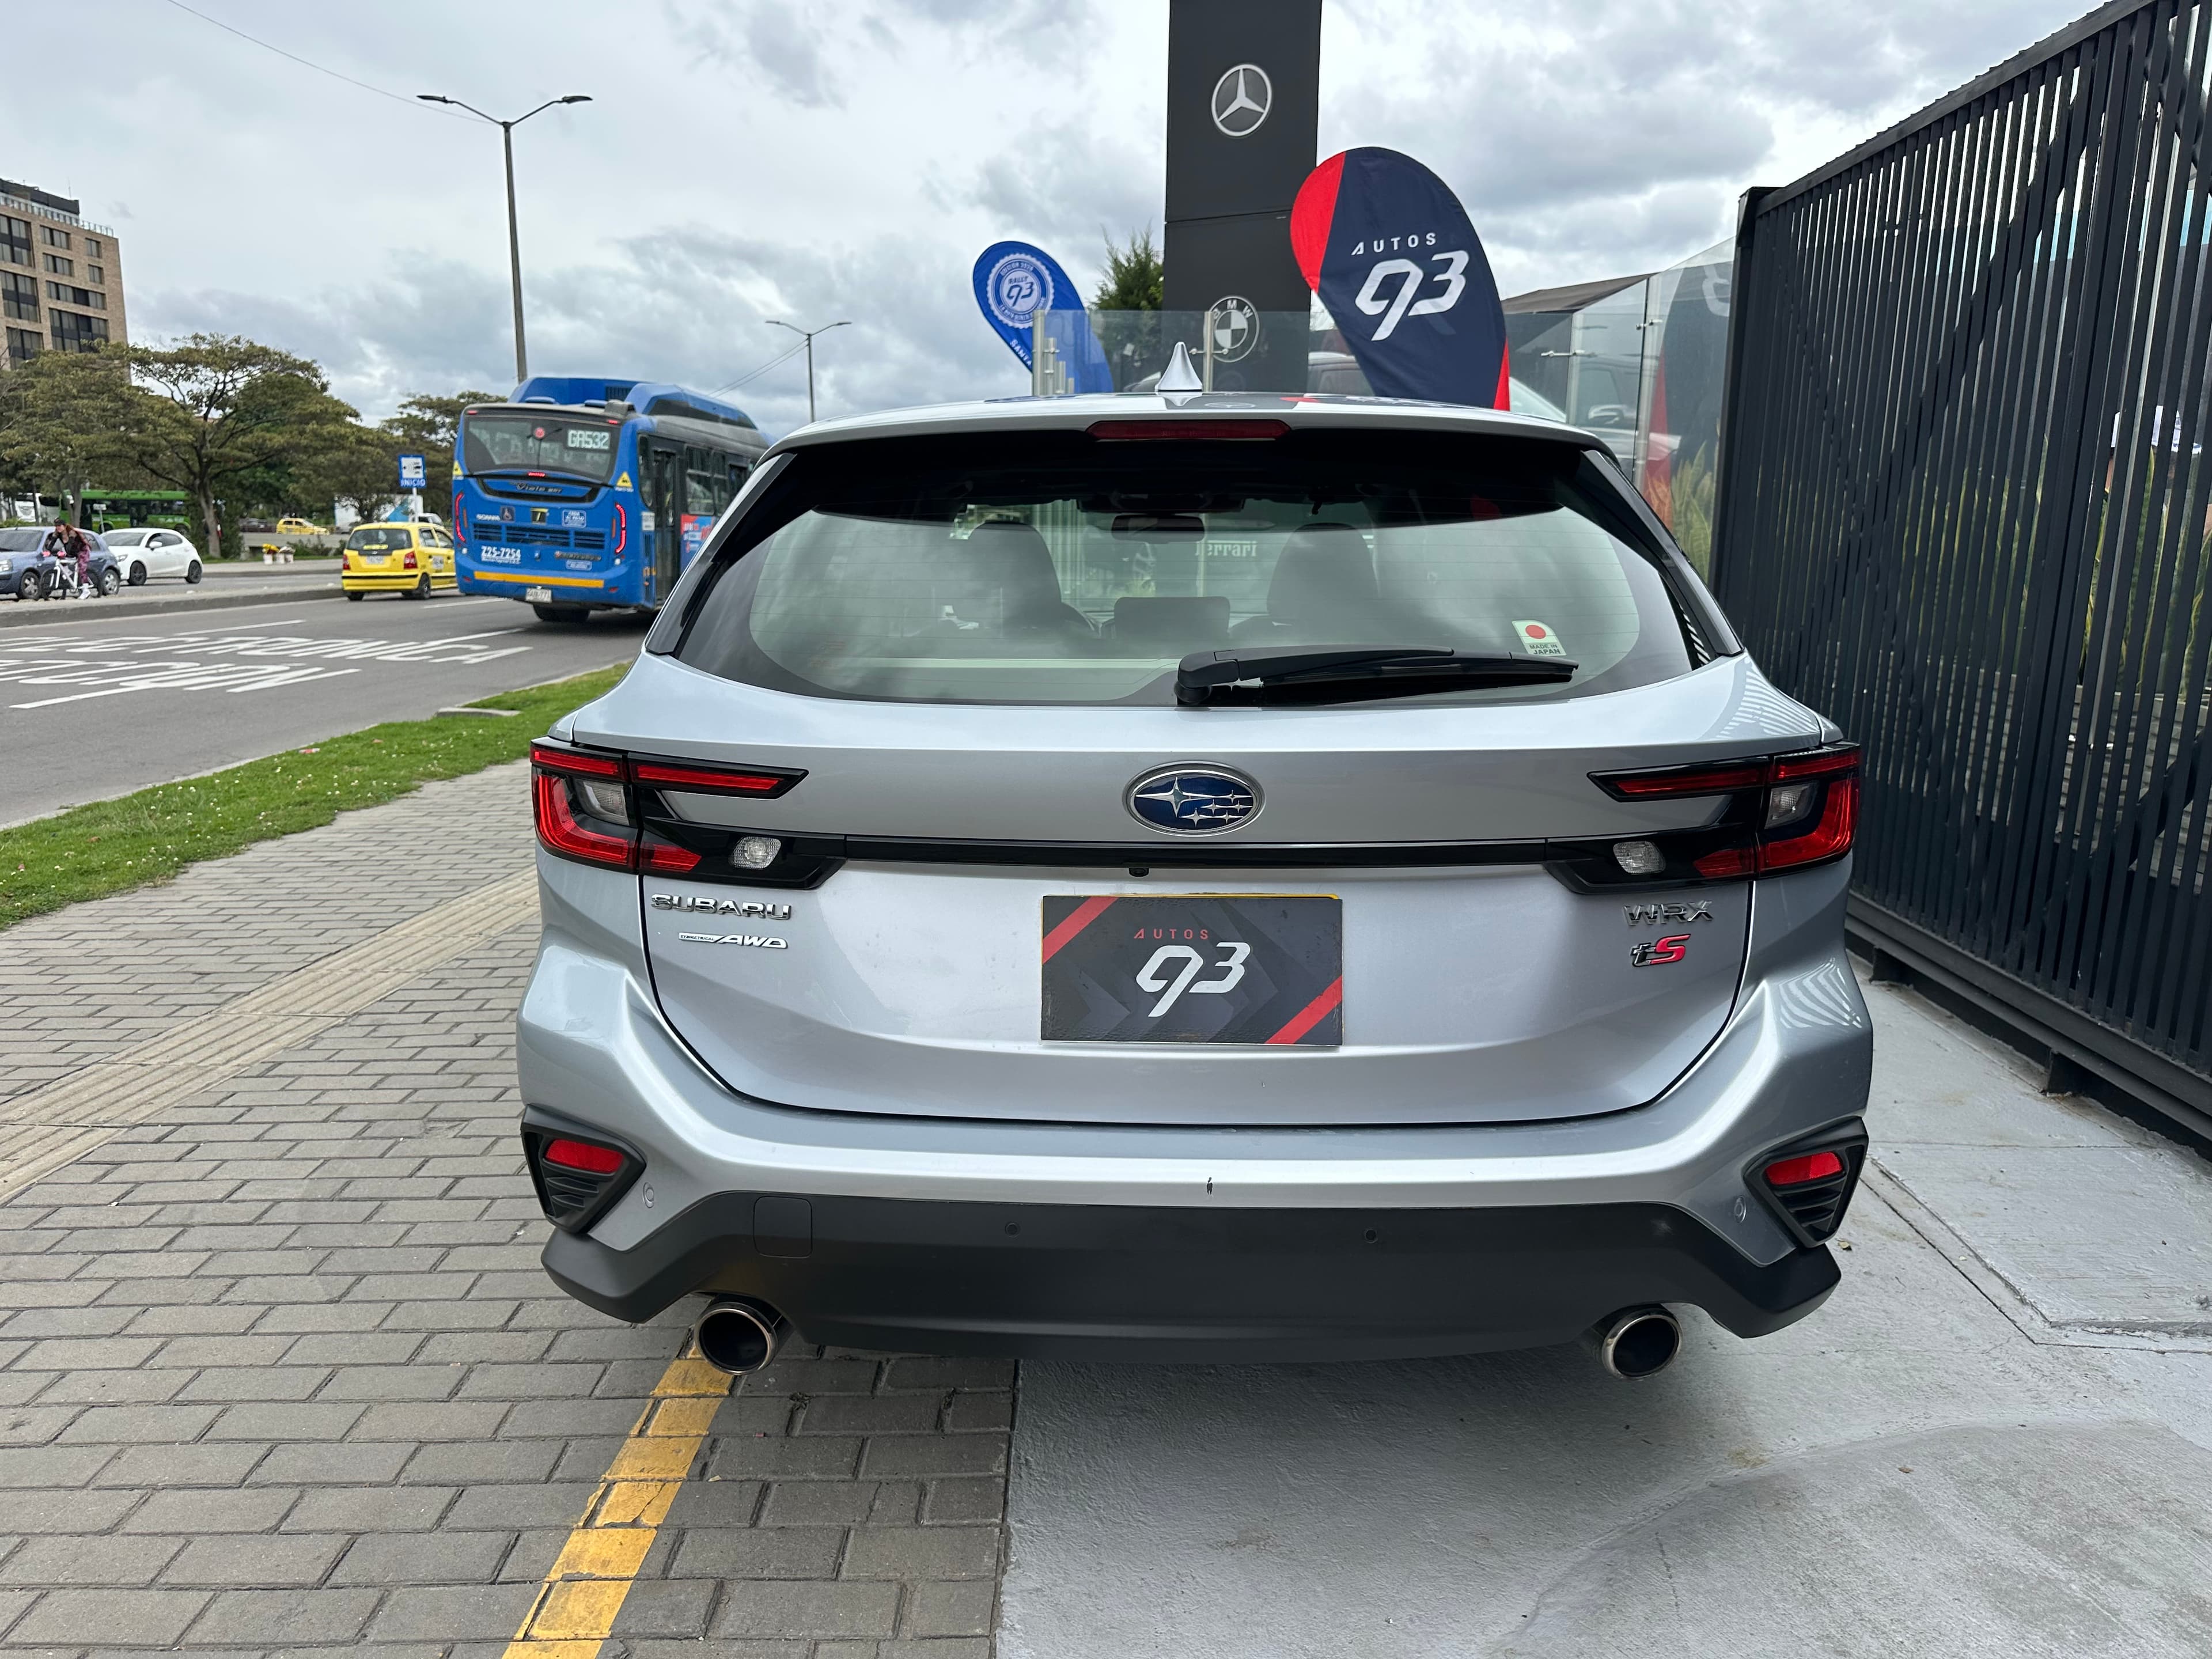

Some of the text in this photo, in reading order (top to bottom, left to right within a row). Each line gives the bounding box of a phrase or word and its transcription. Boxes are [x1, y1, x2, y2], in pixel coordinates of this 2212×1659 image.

[1351, 232, 1437, 256] AUTOS
[1007, 282, 1034, 307] 93
[1355, 250, 1469, 342] 93
[1212, 300, 1254, 320] BMW
[567, 430, 609, 449] GA532
[400, 479, 426, 487] INICIO
[651, 893, 792, 920] SUBARU
[1622, 900, 1714, 926] WRX
[717, 934, 789, 949] AWD
[1134, 928, 1209, 940] AUTOS
[1630, 933, 1691, 967] tS
[1136, 942, 1251, 1017] 93
